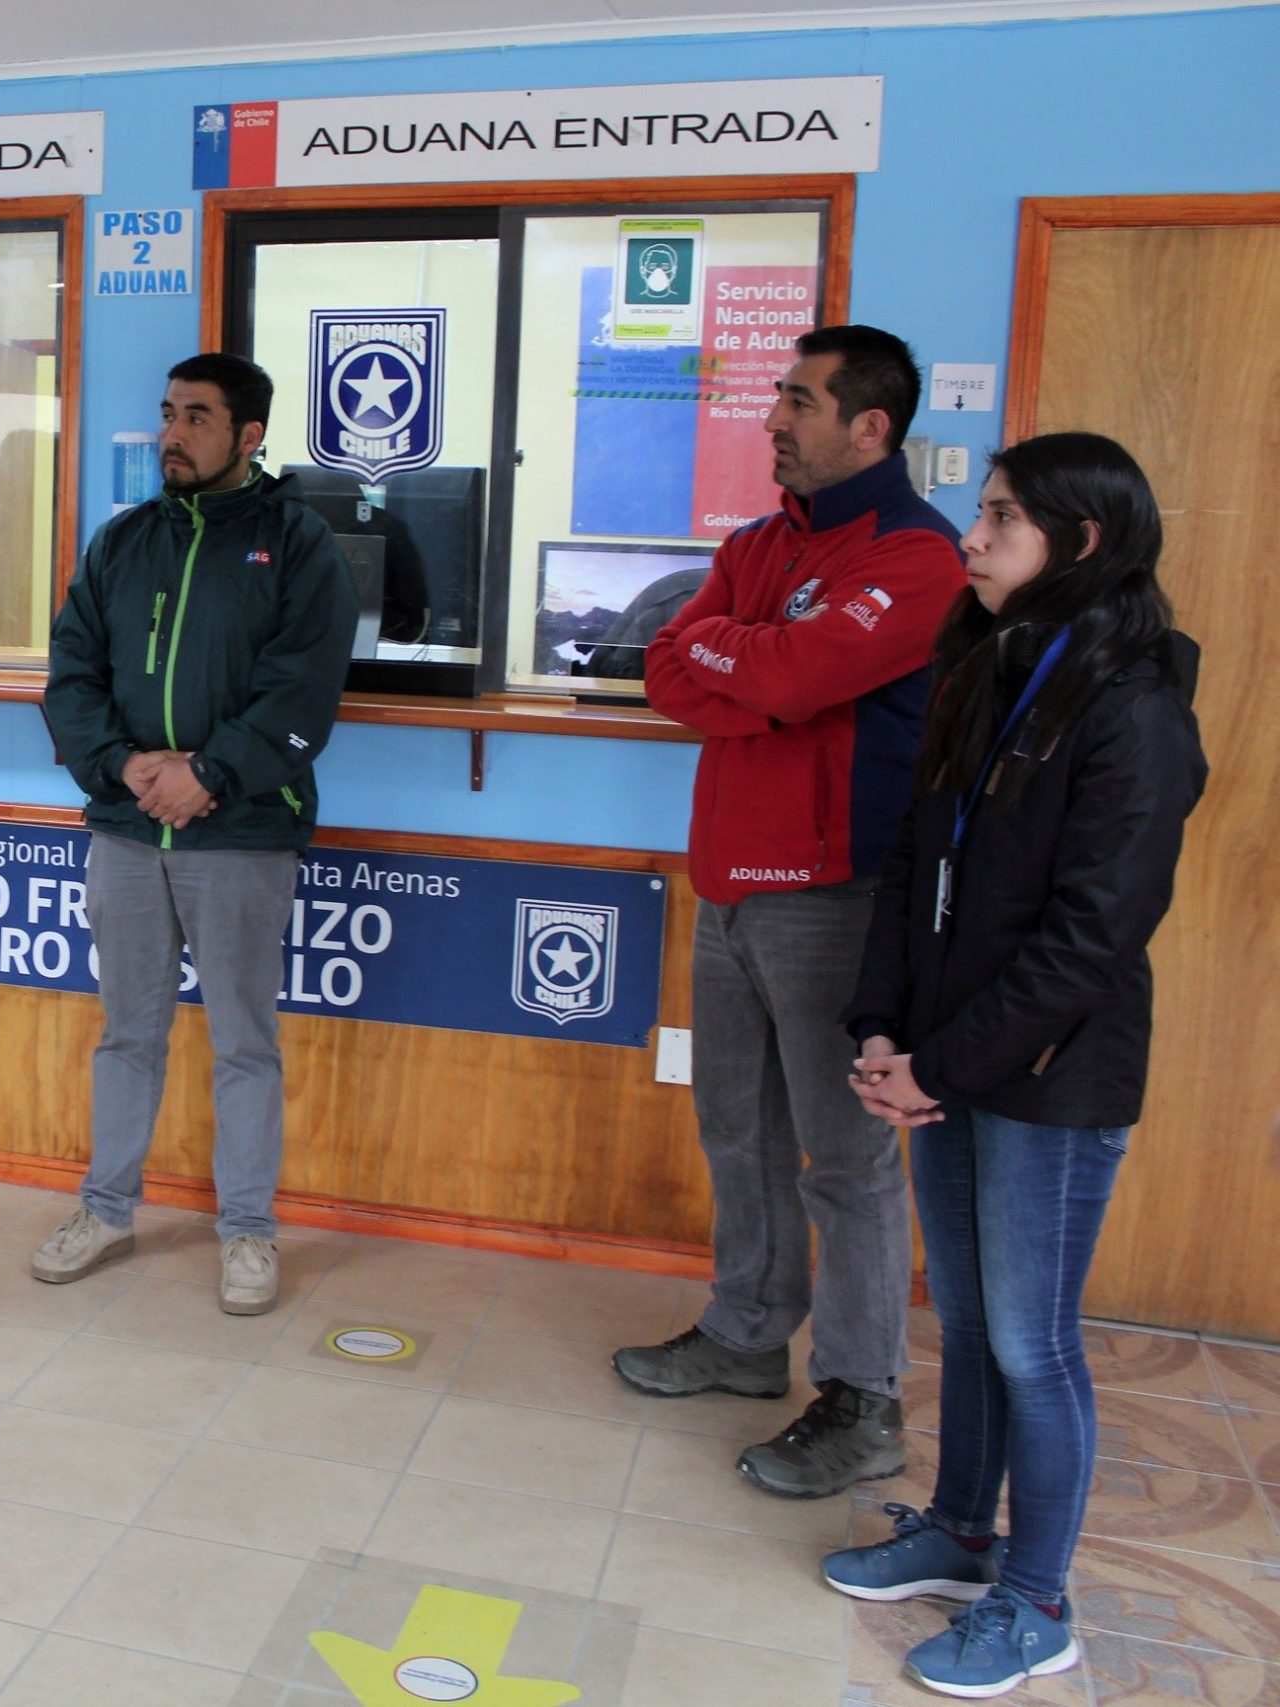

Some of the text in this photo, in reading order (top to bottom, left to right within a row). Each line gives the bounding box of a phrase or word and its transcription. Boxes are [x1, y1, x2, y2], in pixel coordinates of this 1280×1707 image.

[233, 109, 274, 118] Gobierno
[233, 118, 270, 128] de Chile
[302, 109, 839, 157] ADUANA ENTRADA
[103, 210, 183, 236] PASO
[133, 241, 151, 264] 2
[98, 269, 188, 294] ADUANA
[716, 281, 808, 301] Servicio
[715, 306, 815, 325] Nacional
[328, 324, 427, 366] ADUANAS
[714, 331, 797, 350] de Adua
[934, 379, 985, 390] TIMBRE
[732, 407, 757, 418] Don
[339, 428, 411, 460] CHILE
[704, 513, 758, 527] Gobier
[352, 861, 461, 898] Arenas
[729, 867, 811, 882] ADUANAS
[534, 984, 591, 1010] CHILE
